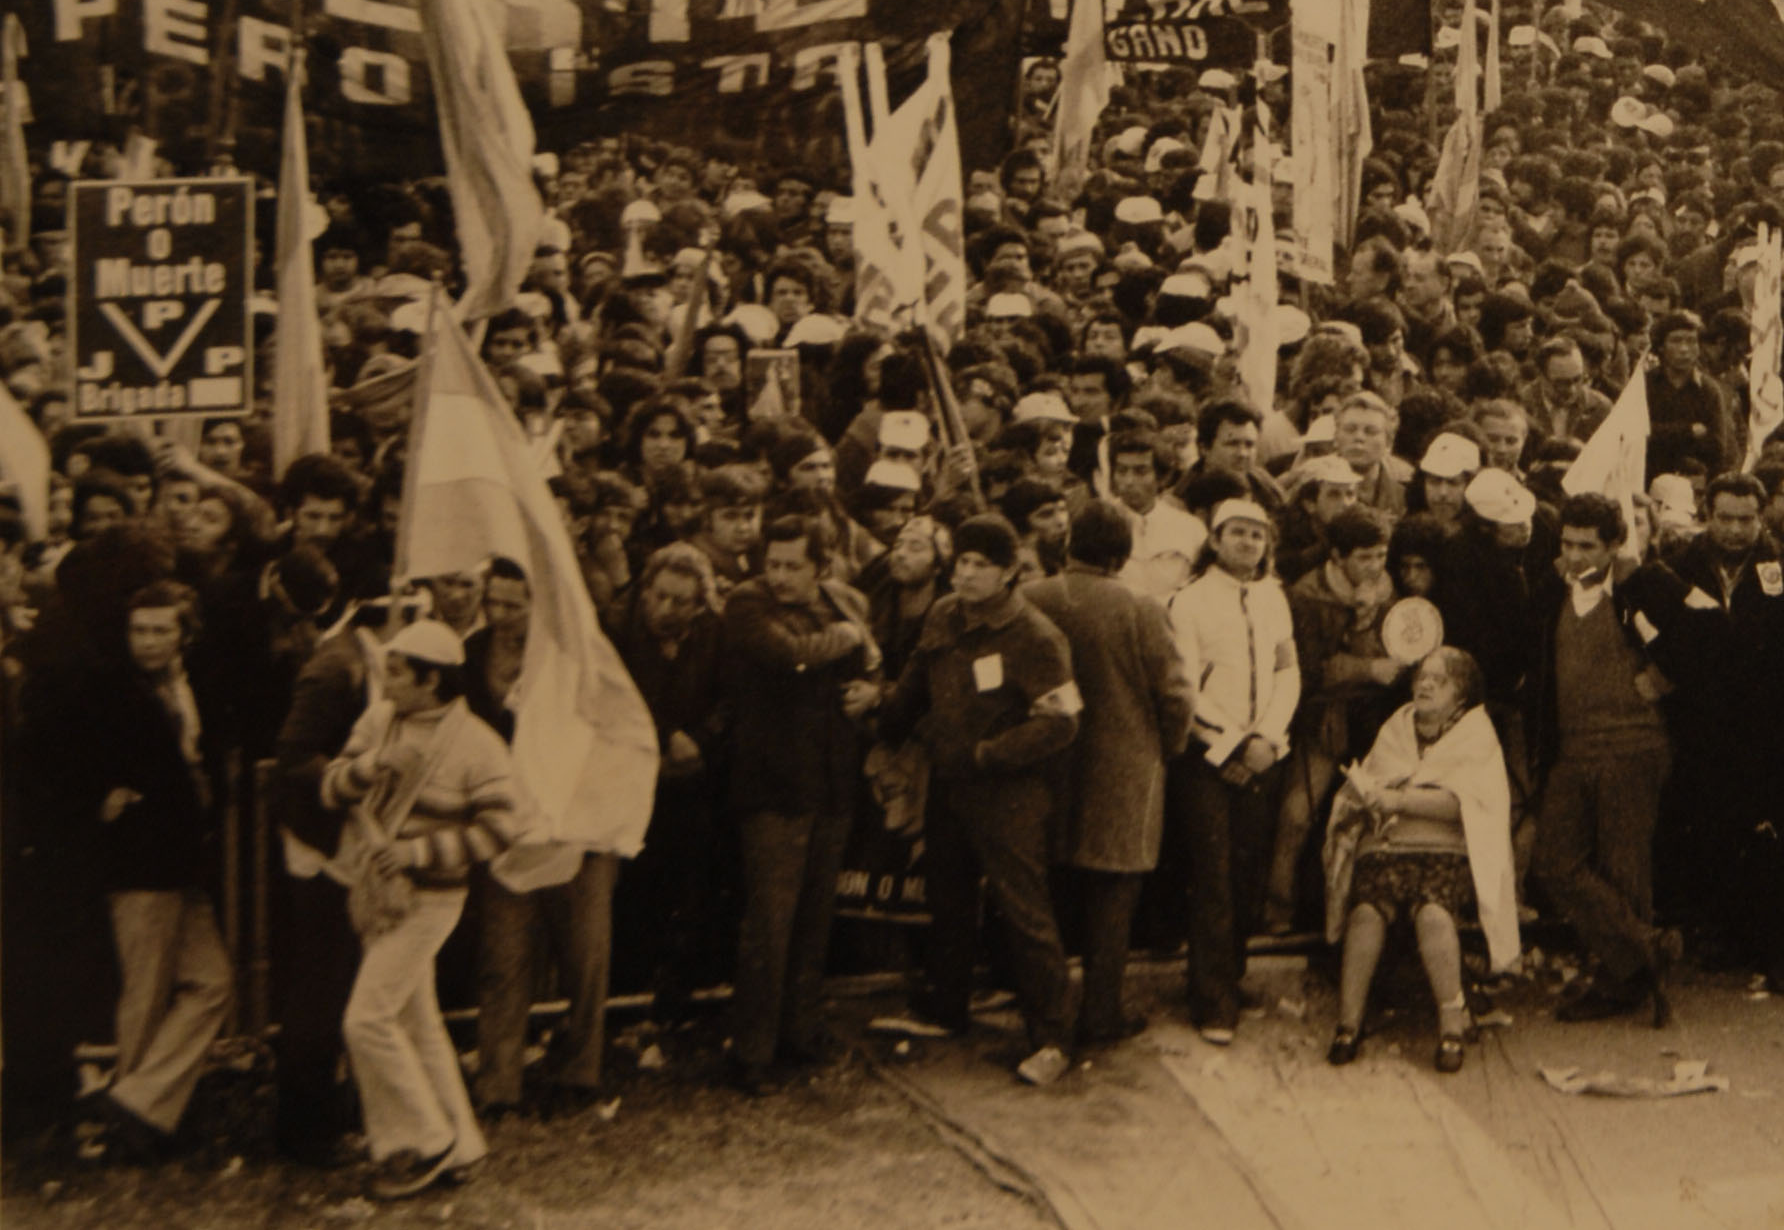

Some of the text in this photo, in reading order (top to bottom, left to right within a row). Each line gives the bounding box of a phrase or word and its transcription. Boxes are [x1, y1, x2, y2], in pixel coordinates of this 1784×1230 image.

[106, 185, 217, 227] Perón
[95, 255, 227, 299] Muerte
[78, 379, 187, 415] Brigada
